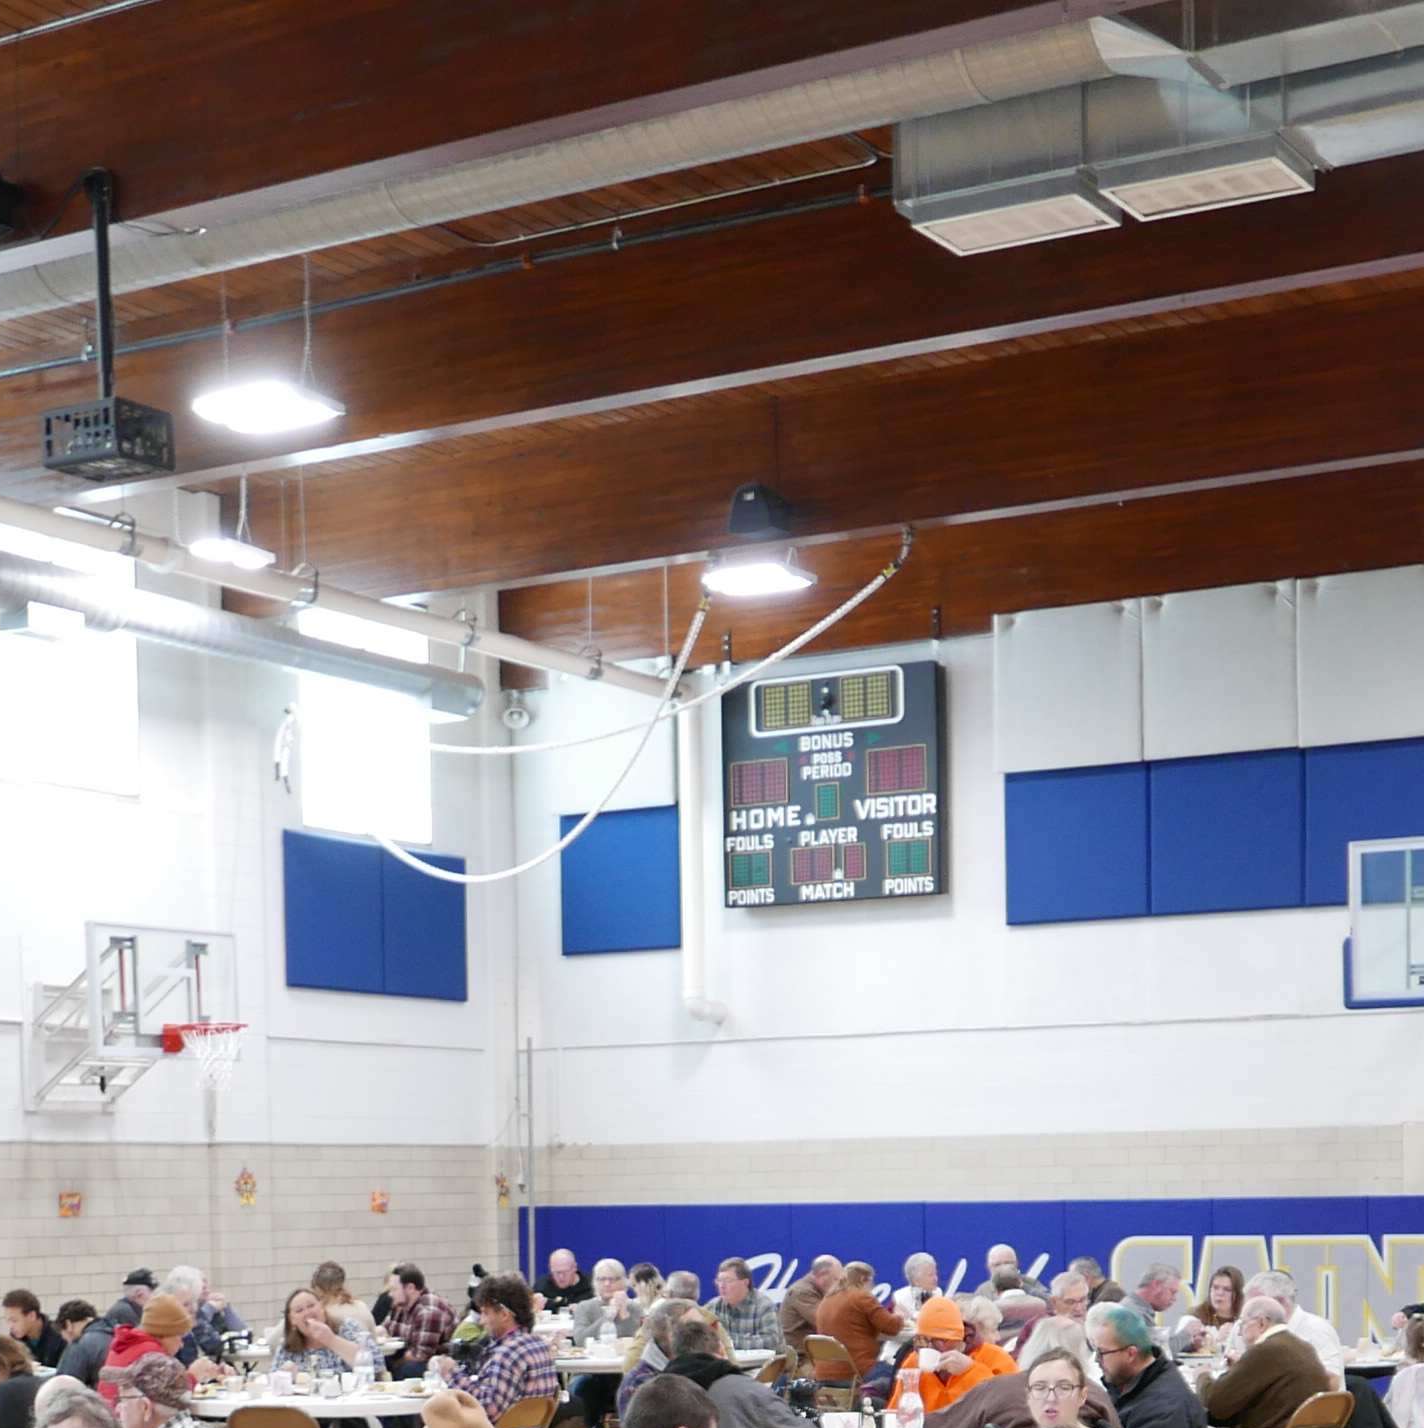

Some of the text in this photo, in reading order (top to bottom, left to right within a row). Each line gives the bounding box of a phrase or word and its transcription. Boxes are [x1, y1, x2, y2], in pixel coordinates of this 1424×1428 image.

[799, 731, 854, 751] BONUS
[812, 752, 842, 764] POSS
[800, 762, 853, 780] PERIOD
[854, 794, 937, 820] VISITOR
[730, 806, 801, 830] HOME
[798, 827, 858, 846] PLAYER
[882, 821, 934, 840] FOULS
[726, 834, 775, 852] FOULS
[799, 882, 855, 900] MATCH
[884, 877, 935, 895] POINTS
[729, 888, 775, 905] POINTS
